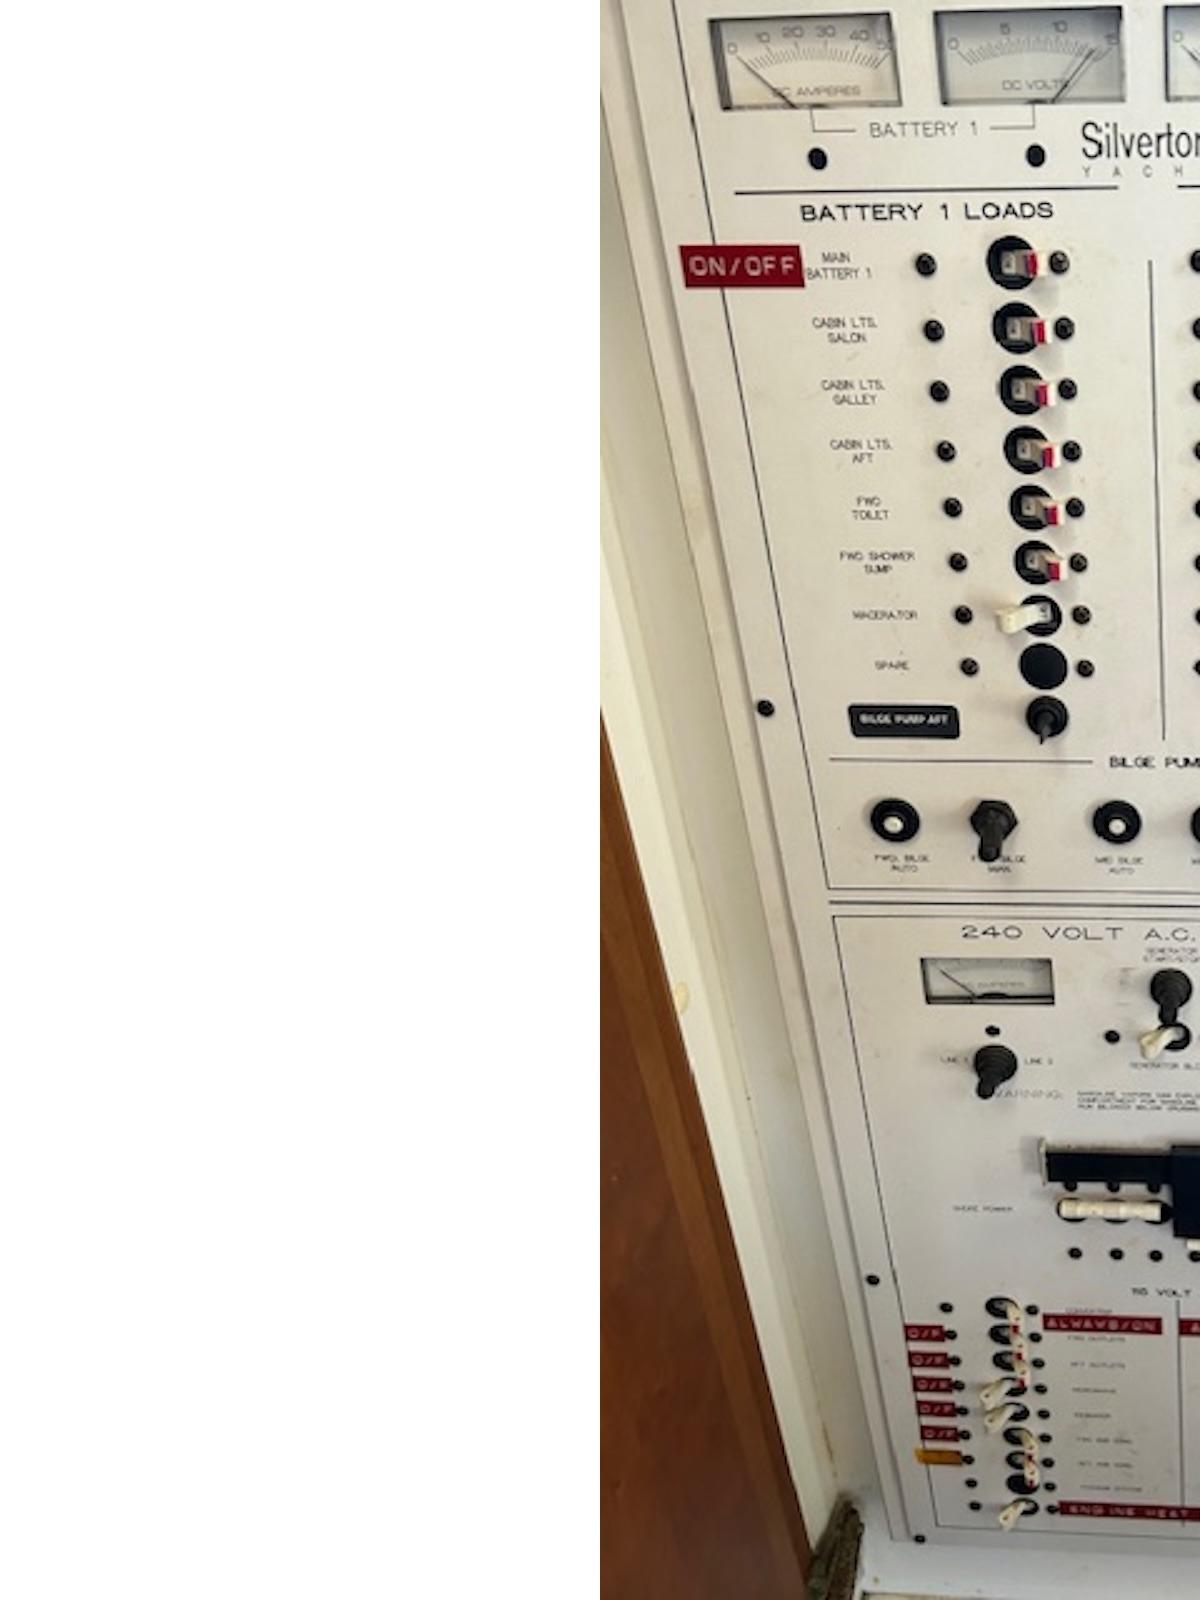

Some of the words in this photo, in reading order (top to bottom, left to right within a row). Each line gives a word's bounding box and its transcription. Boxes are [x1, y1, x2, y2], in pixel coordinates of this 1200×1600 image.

[727, 42, 738, 55] 0
[756, 31, 771, 43] 10
[782, 25, 804, 39] 20
[815, 25, 836, 38] 30
[849, 29, 871, 42] 40
[1173, 30, 1184, 43] 0
[948, 37, 960, 50] 0
[797, 85, 862, 97] AMPERES
[1002, 79, 1023, 91] DC
[869, 121, 960, 138] BATTERY
[970, 121, 979, 136] 1
[800, 203, 923, 223] BATTERY
[940, 204, 950, 219] 1
[964, 201, 1055, 220] LOADS
[821, 252, 851, 264] MAIN
[689, 254, 796, 277] ON/OFF
[806, 267, 860, 280] BATTERY
[811, 317, 846, 330] CABIN
[850, 317, 878, 329] LTS.
[827, 332, 867, 344] SALON
[821, 379, 855, 391] CABIN
[859, 379, 885, 391] LTS.
[832, 393, 877, 405] GALLEY
[830, 439, 863, 451] CABIN
[866, 439, 893, 451] LTS.
[851, 452, 875, 464] AFT
[852, 509, 889, 521] TOILET
[868, 551, 916, 562] SHOWER
[864, 563, 893, 574] SUMP
[852, 610, 918, 621] MACERATOR
[875, 660, 910, 671] SPARE
[859, 713, 892, 725] BILGE
[893, 713, 926, 725] PUMP
[926, 713, 949, 725] AFT
[1109, 755, 1156, 770] BILGE
[961, 925, 1023, 940] 240
[1041, 926, 1124, 941] VOLT
[1144, 928, 1197, 943] A.C.
[1155, 1287, 1192, 1298] VOLT
